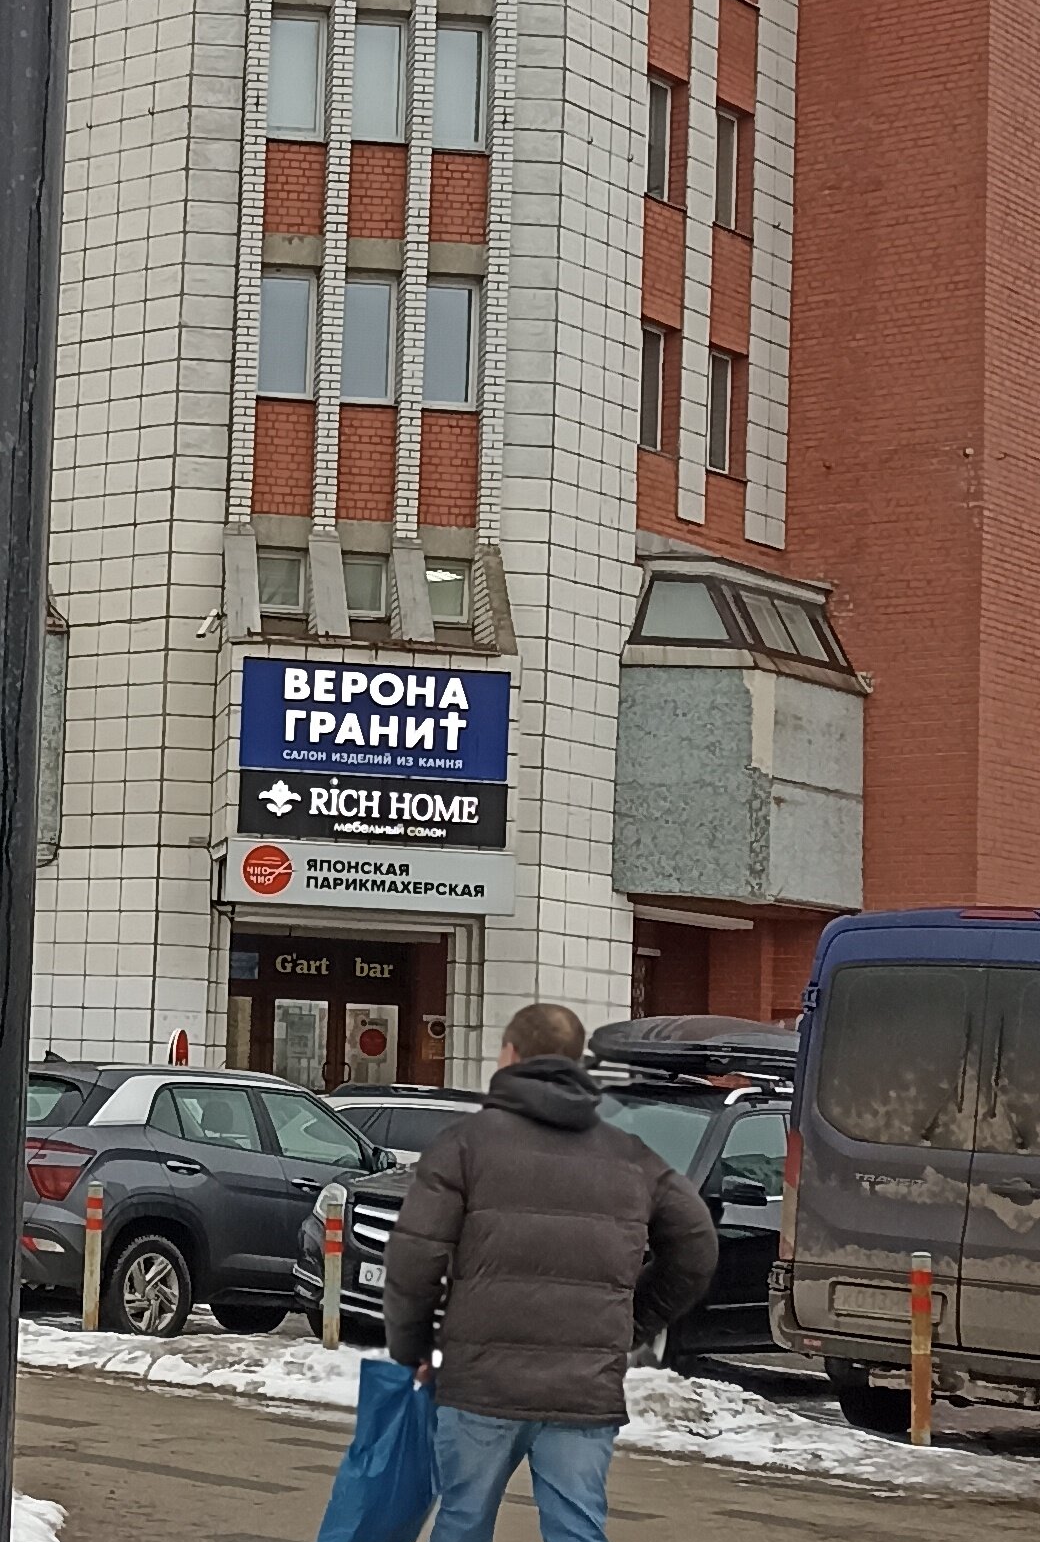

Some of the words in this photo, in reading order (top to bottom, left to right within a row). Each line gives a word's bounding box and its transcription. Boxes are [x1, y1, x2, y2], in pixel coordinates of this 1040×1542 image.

[283, 667, 469, 710] ВЕРОНА
[283, 709, 467, 751] ГРАНИТ
[282, 749, 327, 761] САЛОН
[331, 752, 392, 765] ИЗДЕЛИЙ
[396, 756, 414, 766] ИЗ
[418, 757, 463, 769] КАМНЯ
[388, 791, 479, 824] HOME
[334, 821, 405, 835] мебельный
[406, 826, 447, 838] салон
[306, 858, 410, 877] ЯПОНСКАЯ
[306, 875, 485, 898] ПАРИКМАХЕРСКАЯ
[275, 953, 330, 976] G'art
[355, 957, 394, 979] bar
